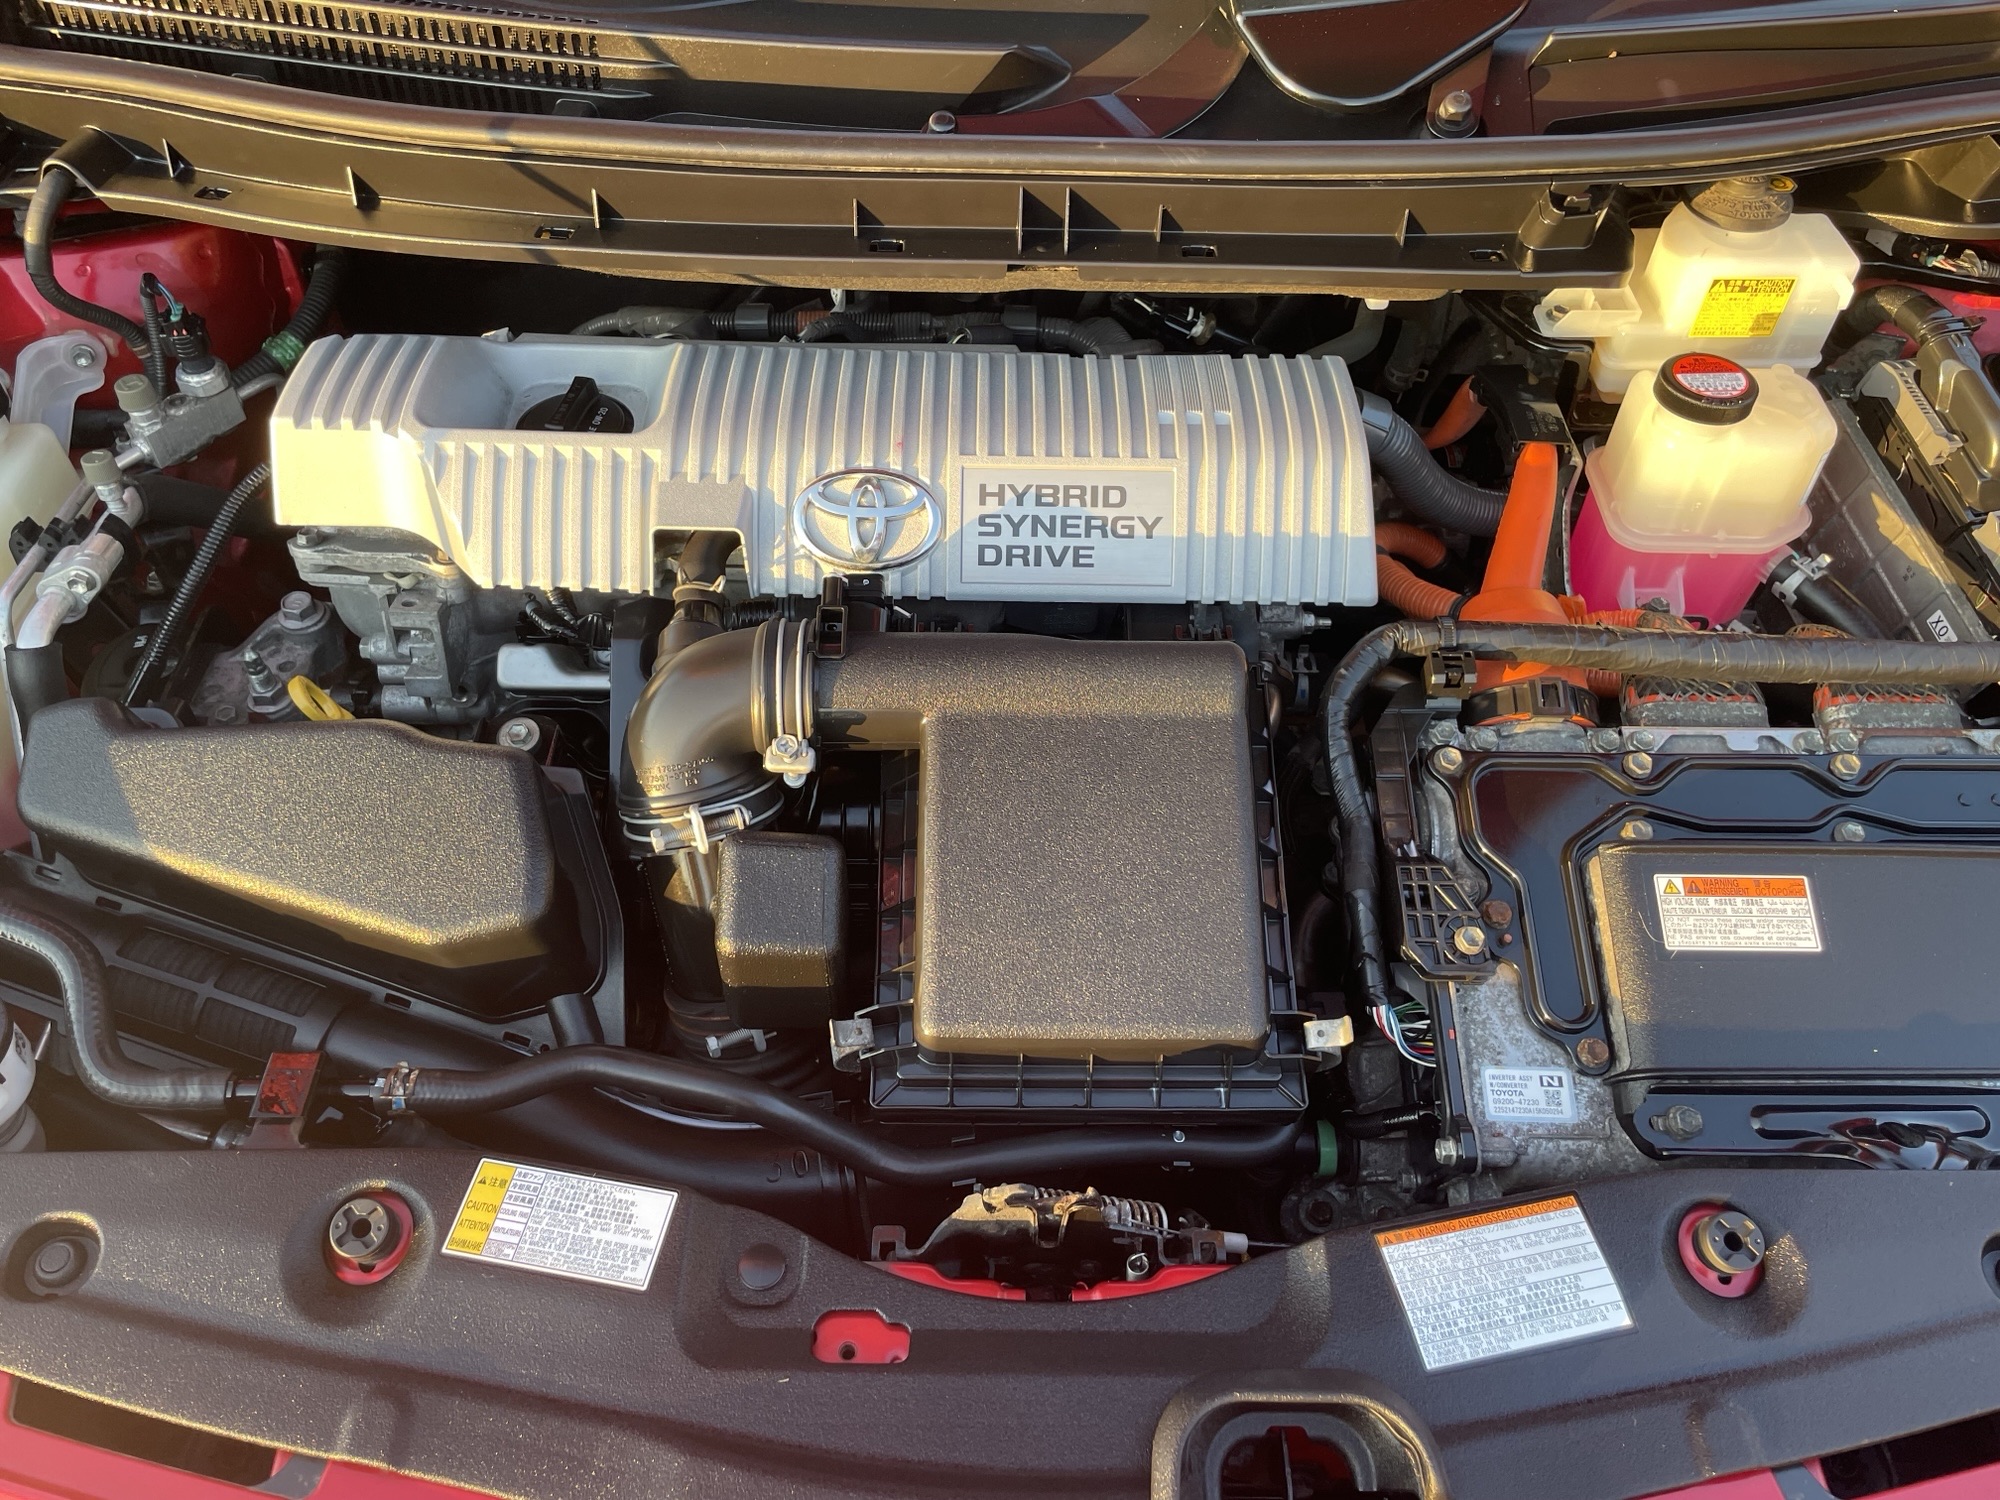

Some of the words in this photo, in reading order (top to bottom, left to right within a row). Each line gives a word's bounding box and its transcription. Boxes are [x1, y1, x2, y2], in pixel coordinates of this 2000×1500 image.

[978, 483, 1127, 508] HYBRID
[977, 514, 1164, 539] SYNERGY
[977, 544, 1095, 568] DRIVE
[1701, 878, 1739, 887] WARNING
[1702, 887, 1750, 895] AVERTISSEMENT
[1490, 1089, 1525, 1097] TOYOTA
[1492, 1098, 1540, 1106] G9200-47230
[487, 1176, 508, 1189] 注意
[464, 1199, 499, 1214] CAUTION
[1525, 1197, 1575, 1215] ОСТОРОЖНО
[457, 1217, 491, 1232] ATTENTION
[529, 1218, 543, 1226] TIME
[544, 1221, 571, 1231] IGNITION
[542, 1210, 560, 1218] AVOID
[561, 1213, 590, 1223] PERSONAL
[613, 1222, 629, 1230] KEEP
[547, 1216, 564, 1224] FROM
[612, 1228, 630, 1236] START
[1416, 1221, 1457, 1237] WARNING
[1455, 1207, 1525, 1229] AVERTISSEMENT
